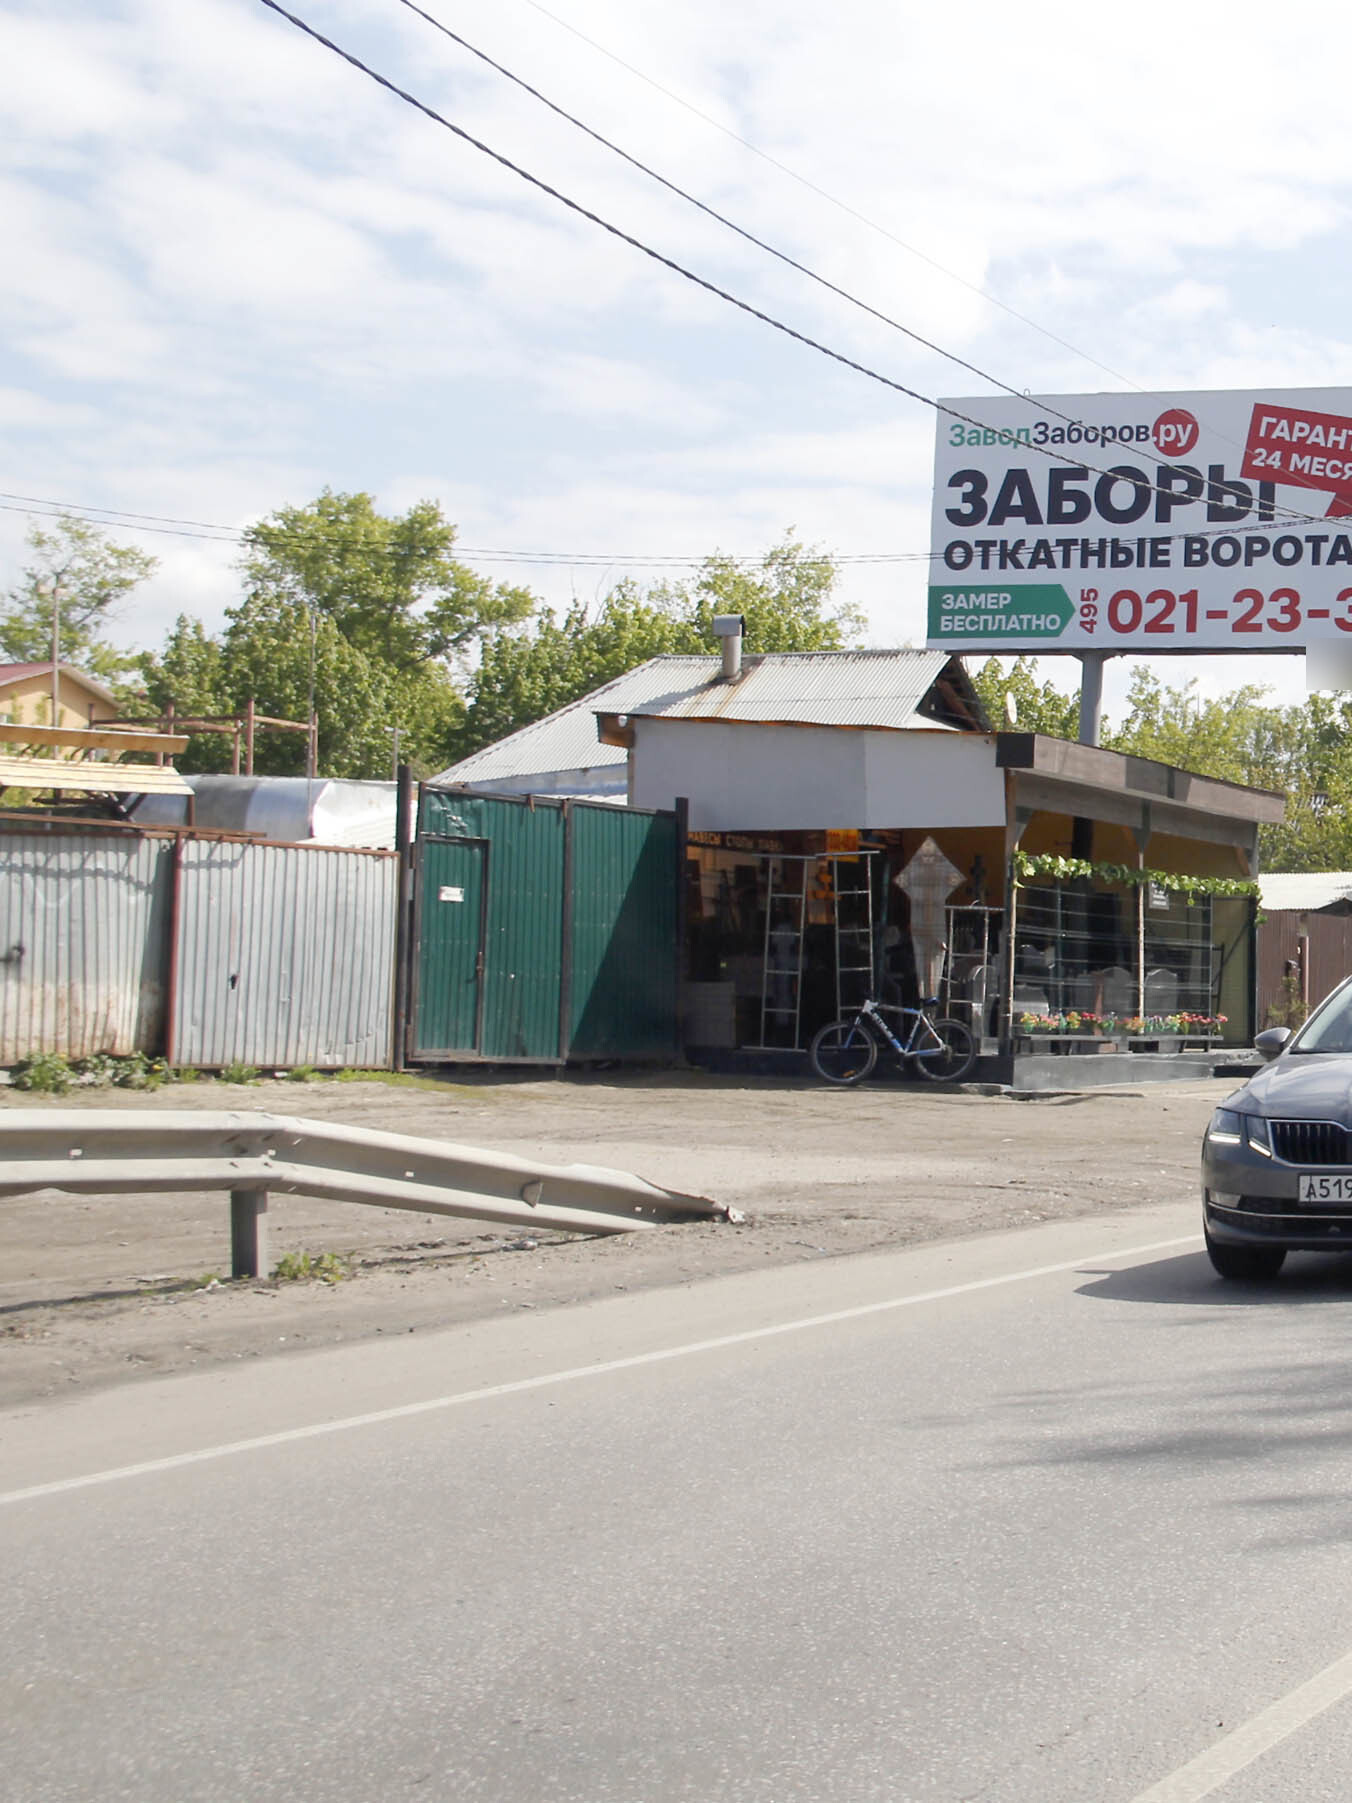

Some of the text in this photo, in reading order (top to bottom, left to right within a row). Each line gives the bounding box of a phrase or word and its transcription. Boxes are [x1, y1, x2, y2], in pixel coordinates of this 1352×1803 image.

[1252, 447, 1281, 469] 24
[945, 464, 1276, 527] ЗАБОРЫ
[943, 536, 1171, 571] ОТКАТНЫЕ
[941, 593, 1011, 610] ЗАМЕР
[1079, 588, 1099, 634] 495
[940, 614, 1061, 632] БЕСПЛАТНО
